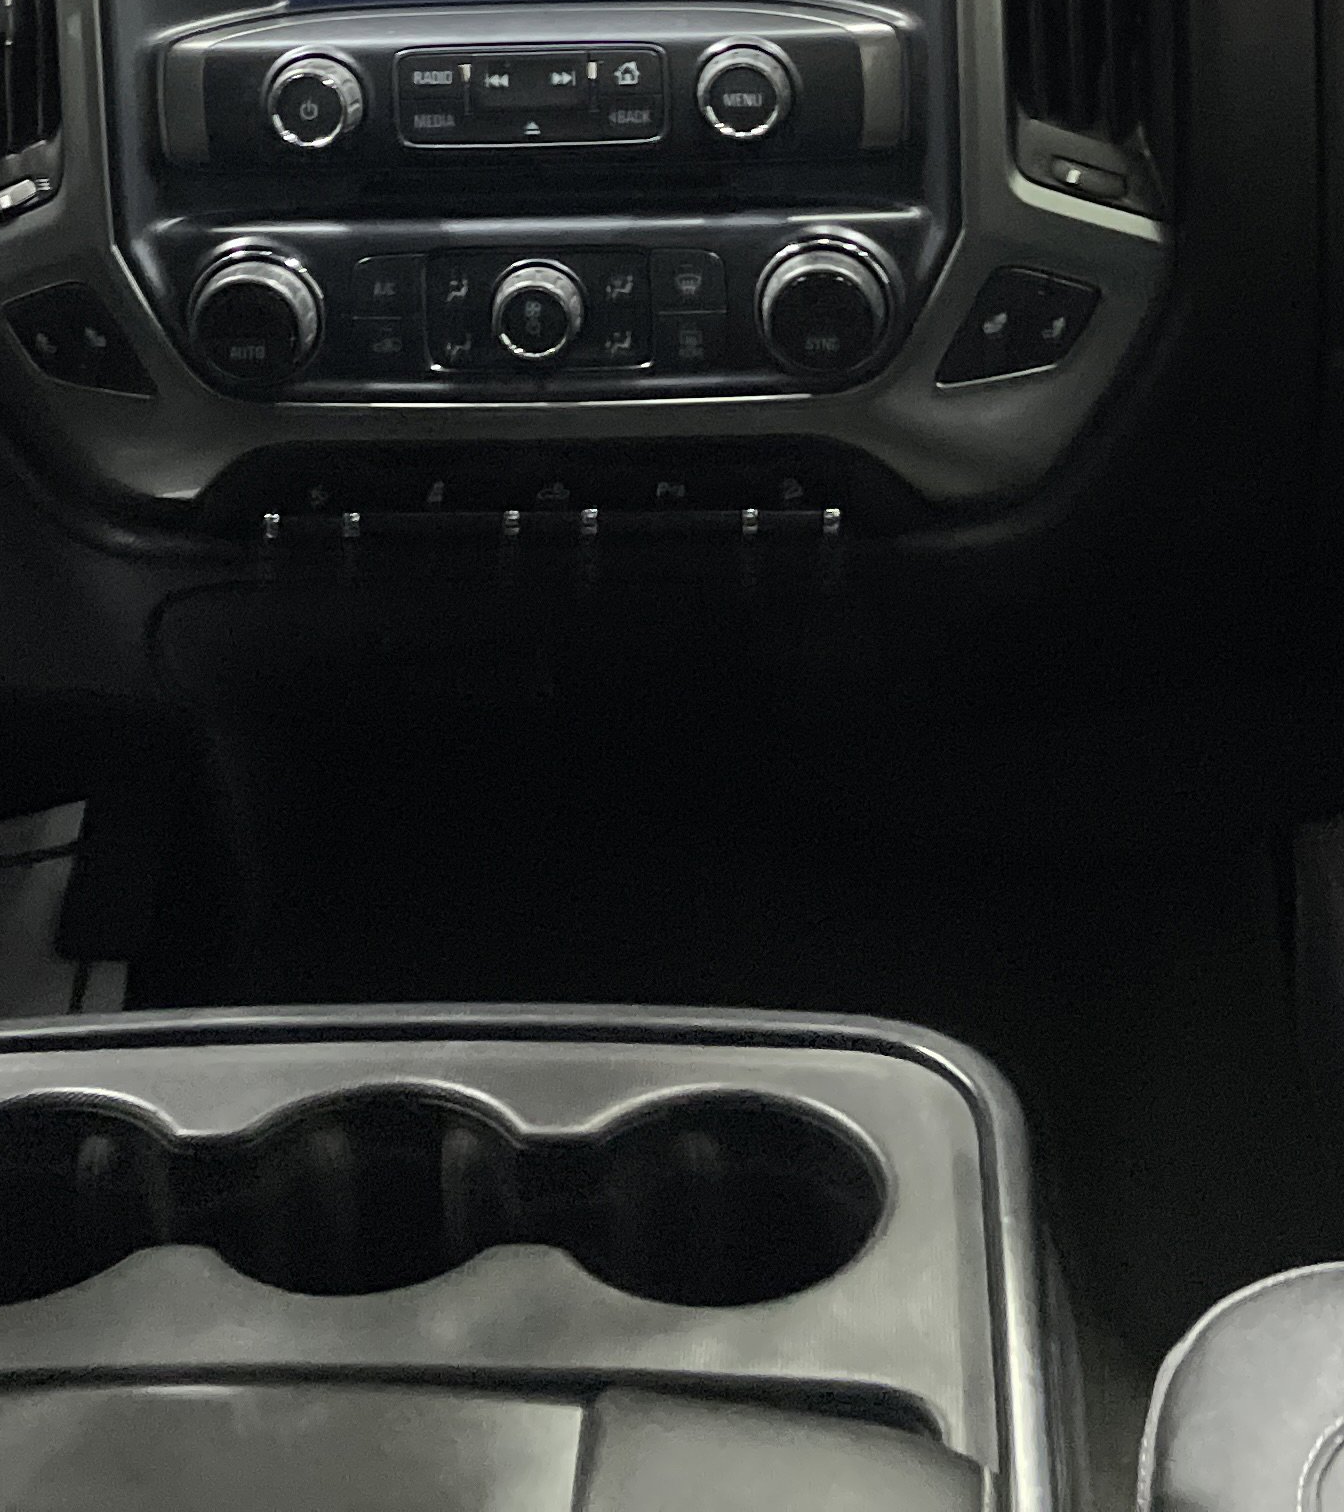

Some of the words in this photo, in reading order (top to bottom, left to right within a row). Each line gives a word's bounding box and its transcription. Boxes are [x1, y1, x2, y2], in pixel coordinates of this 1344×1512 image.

[412, 69, 454, 86] RADIO
[722, 92, 763, 107] MENU
[412, 113, 456, 129] MEDIA
[616, 108, 653, 125] BACK
